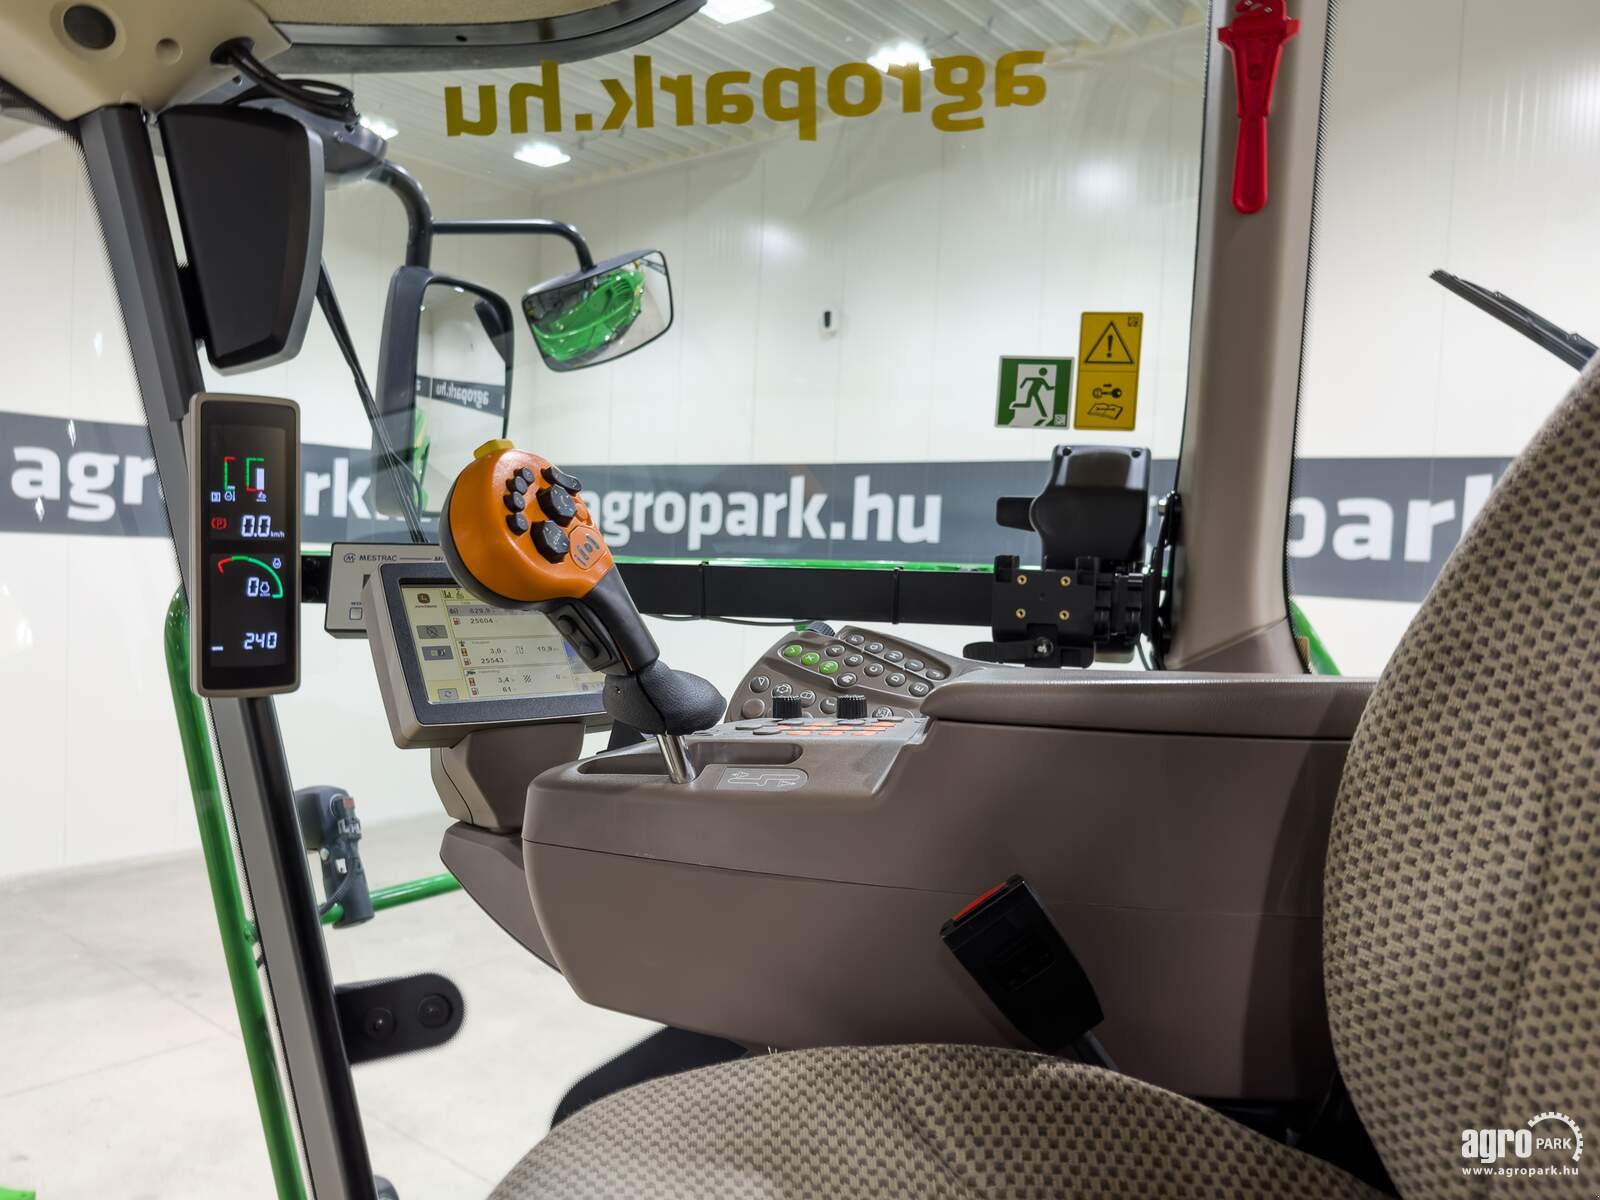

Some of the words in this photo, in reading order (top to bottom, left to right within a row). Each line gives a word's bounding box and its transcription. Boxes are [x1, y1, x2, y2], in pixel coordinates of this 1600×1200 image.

[241, 514, 271, 537] 0.0
[270, 530, 285, 538] km/h
[243, 631, 278, 650] 240
